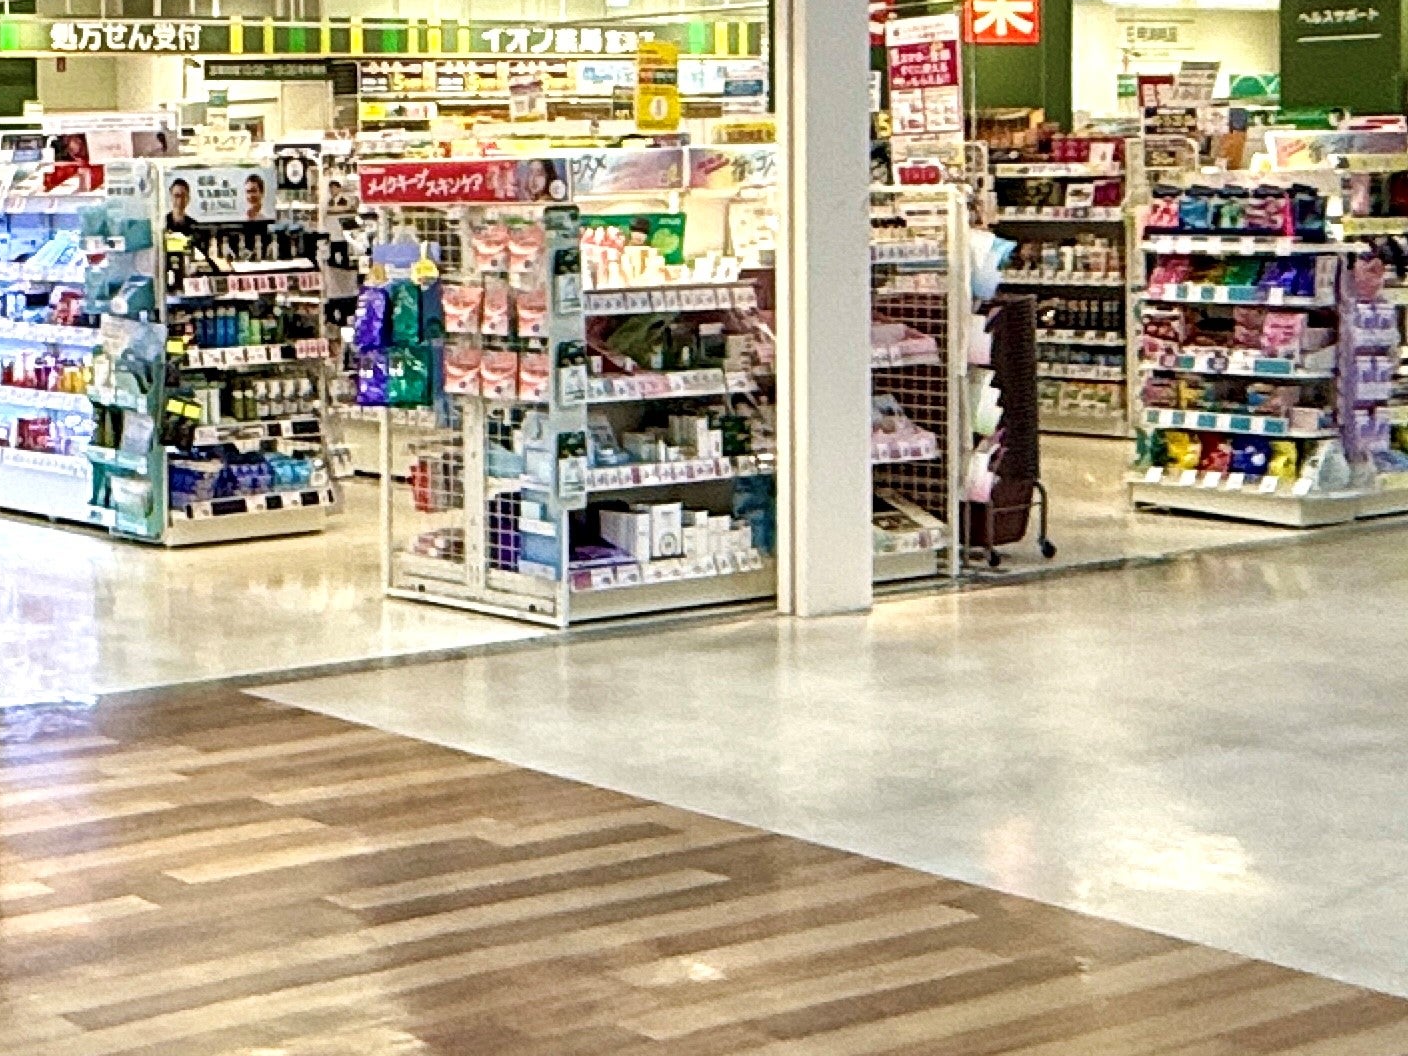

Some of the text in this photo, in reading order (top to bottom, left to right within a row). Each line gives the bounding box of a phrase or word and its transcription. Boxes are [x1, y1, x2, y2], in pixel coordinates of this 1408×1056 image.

[1298, 6, 1381, 25] ヘルスサポート
